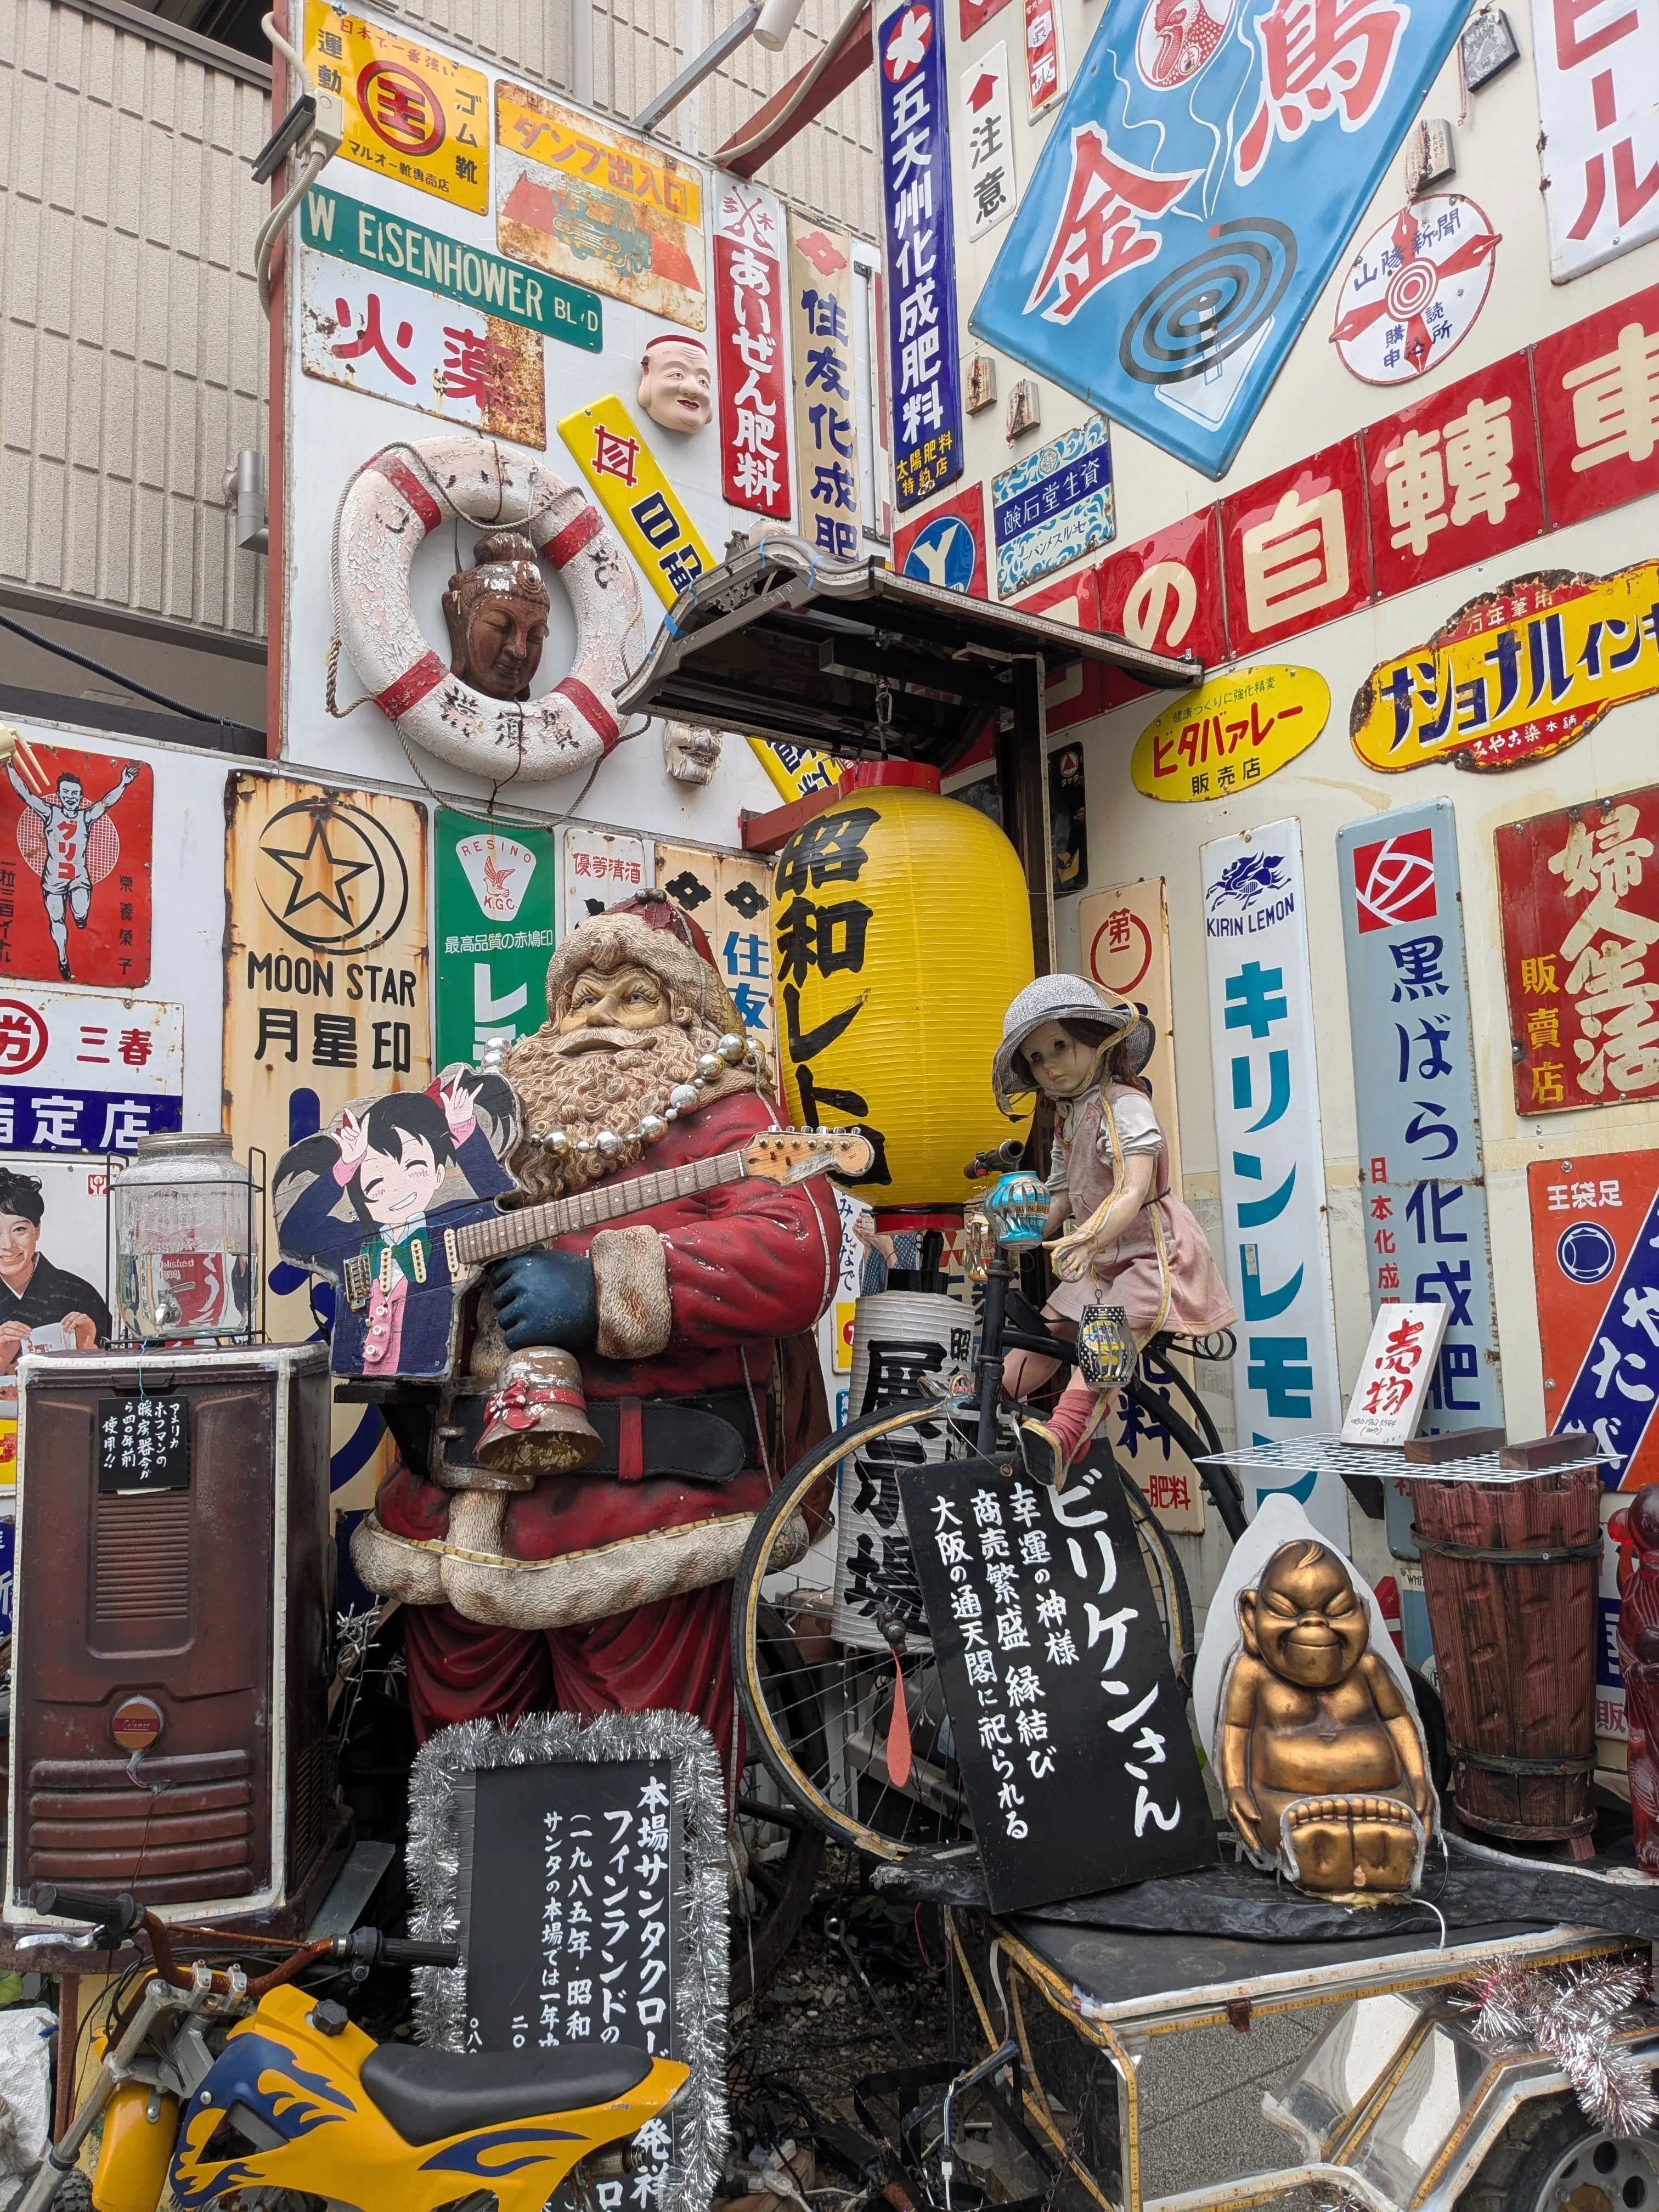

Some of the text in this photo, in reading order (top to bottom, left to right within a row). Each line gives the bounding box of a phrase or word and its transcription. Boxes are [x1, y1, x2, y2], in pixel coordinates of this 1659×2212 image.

[318, 29, 342, 94] 運動
[341, 19, 455, 77] 日本で一番強い
[454, 89, 481, 185] ゴム靴
[969, 116, 1007, 224] 注意
[308, 193, 336, 240] W
[359, 211, 544, 322] EISENHOWER
[890, 72, 944, 445] 五大州化成肥料
[1354, 208, 1461, 292] 山陽新聞
[331, 292, 518, 419] 火薬
[730, 248, 782, 507] あいぜん肥料
[896, 430, 952, 482] 太陽肥料
[902, 456, 947, 496] 特約店
[1466, 590, 1553, 635] 万年筆用
[1153, 702, 1303, 778] ビタバァレー
[1191, 757, 1261, 797] 販売店
[57, 820, 77, 881] グリコ
[461, 839, 532, 864] RESINO
[573, 852, 641, 884] 優等清酒
[444, 929, 553, 955] 最高品質の赤鳩印
[1206, 892, 1295, 938] KIRIN LEMON
[1547, 804, 1659, 1096] 婦人生活
[247, 952, 417, 1008] MOON STAR
[76, 1026, 153, 1066] 三春
[254, 1007, 412, 1075] 月星印
[1388, 935, 1481, 1421] 黒ばら化成肥
[1361, 1318, 1424, 1415] 売物
[1009, 1482, 1079, 1666] 幸運の神様
[930, 1495, 1029, 1840] 大阪の通天閣に祀られる
[970, 1490, 1058, 1780] 商売繁盛 縁結び
[1046, 1468, 1181, 1838] ビリケンさん
[122, 1719, 150, 1731] Coleman
[600, 1810, 632, 2044] フィンランドの
[634, 1775, 669, 2056] 本場サンタクロー
